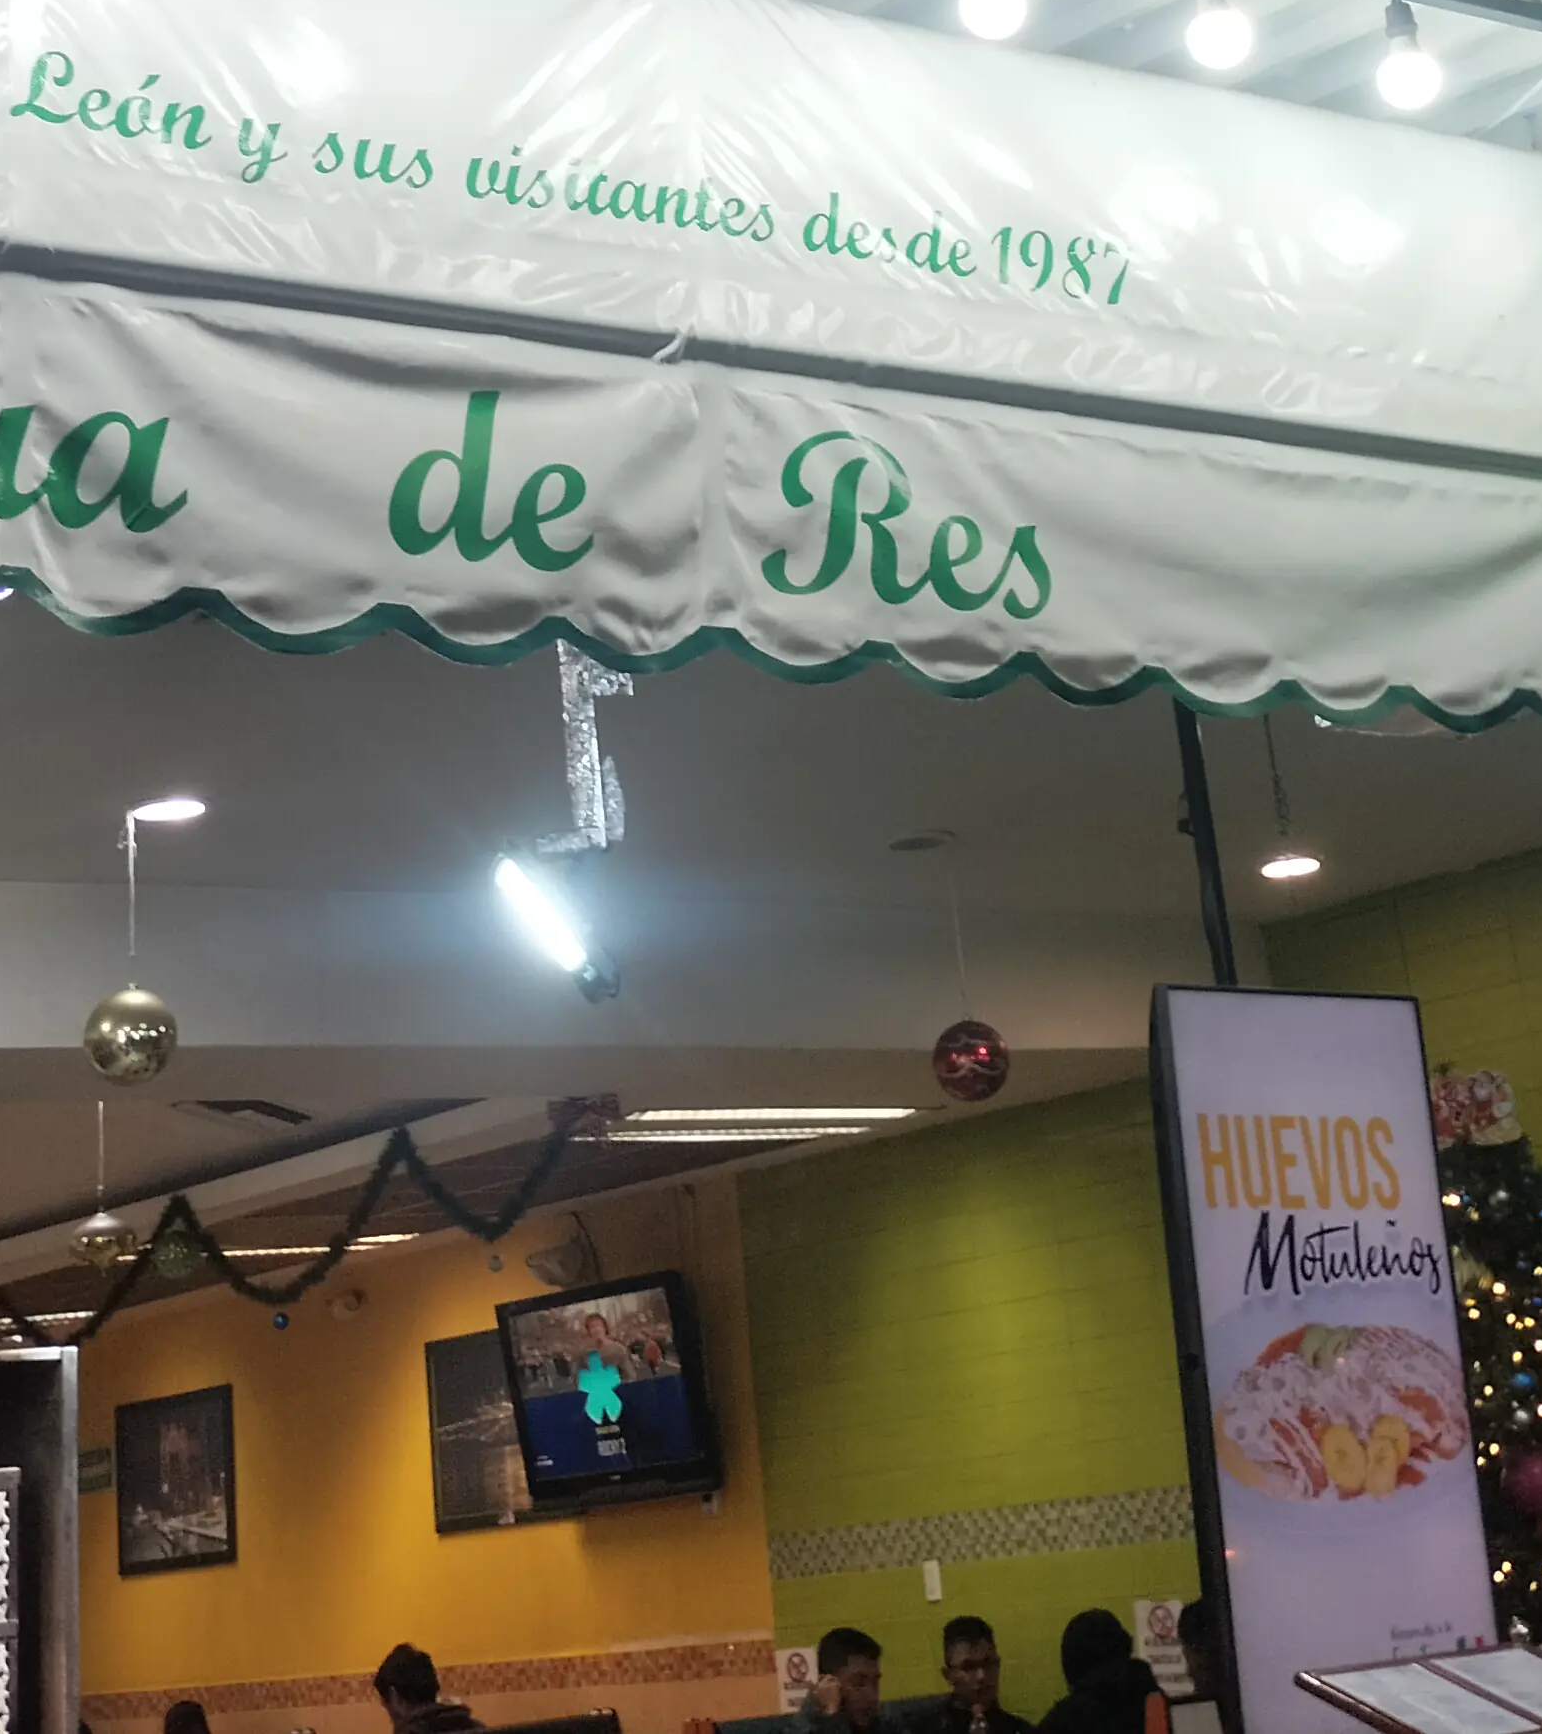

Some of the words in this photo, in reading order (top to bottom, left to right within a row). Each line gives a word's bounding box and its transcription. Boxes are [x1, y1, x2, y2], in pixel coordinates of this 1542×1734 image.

[10, 51, 214, 151] León
[237, 111, 289, 184] y
[312, 130, 435, 190] sus
[466, 144, 775, 243] visitantes
[802, 192, 977, 278] desde
[990, 226, 1131, 306] 1987
[387, 390, 595, 573] de
[760, 430, 1055, 621] Res
[1197, 1113, 1401, 1210] HUEVOS
[1244, 1210, 1442, 1296] Motuleños
